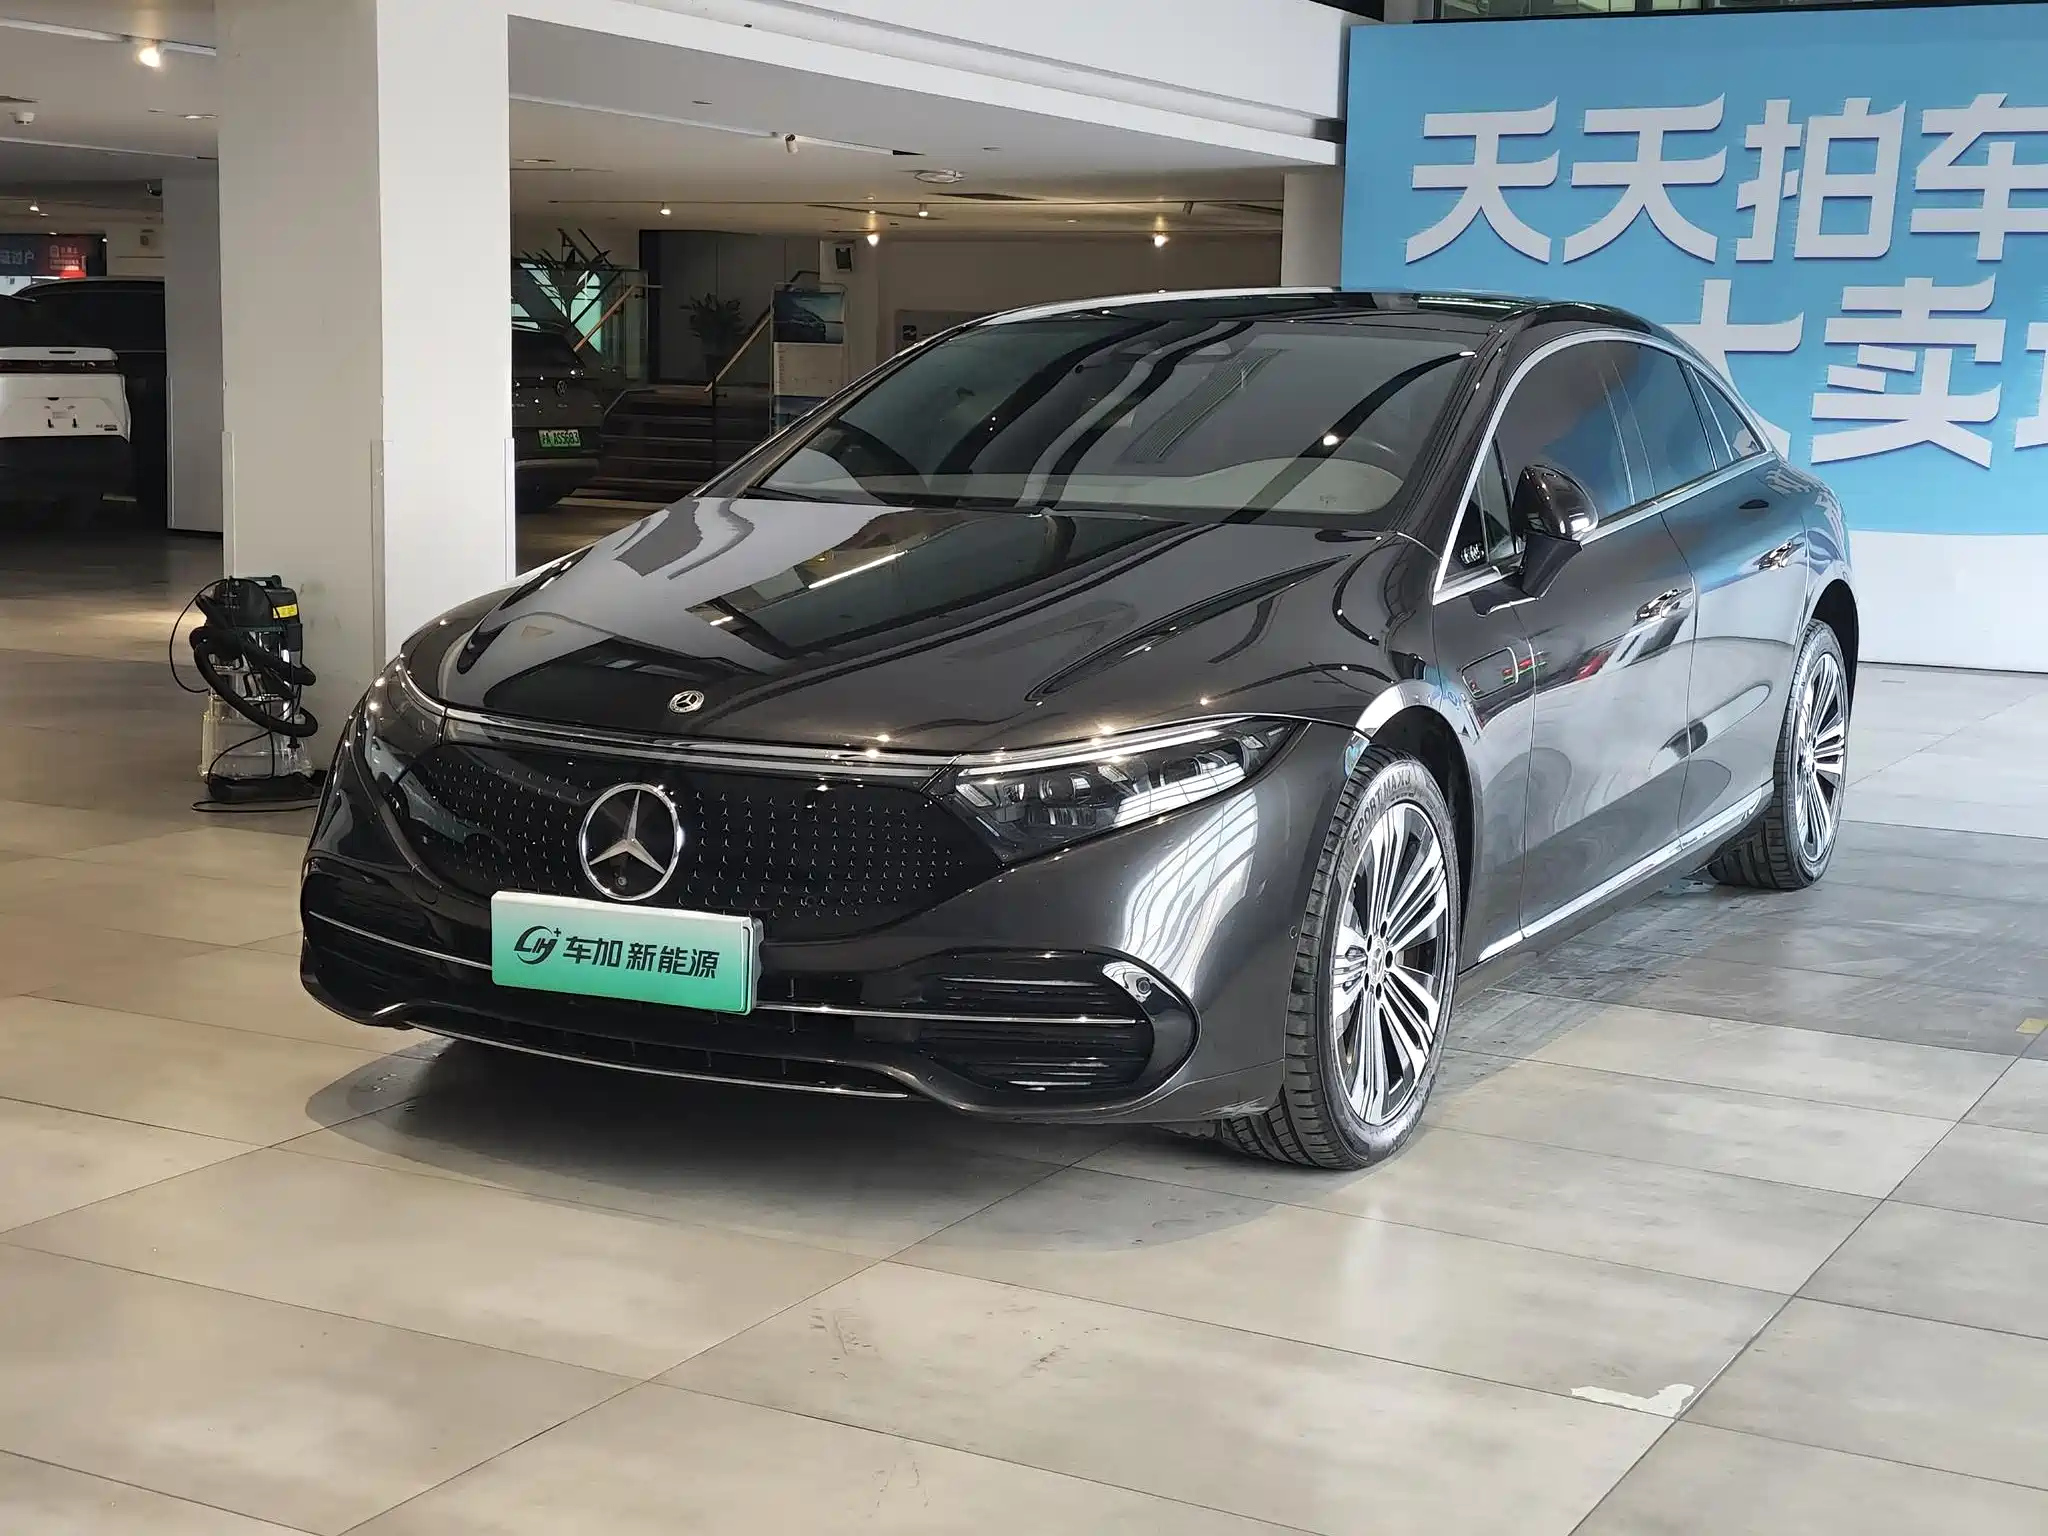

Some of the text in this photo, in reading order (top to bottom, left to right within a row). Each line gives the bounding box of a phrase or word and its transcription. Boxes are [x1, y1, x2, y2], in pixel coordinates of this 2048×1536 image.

[1405, 93, 2048, 264] 天天拍车
[1352, 788, 1383, 845] SPORT
[562, 936, 720, 979] 车加新能源
